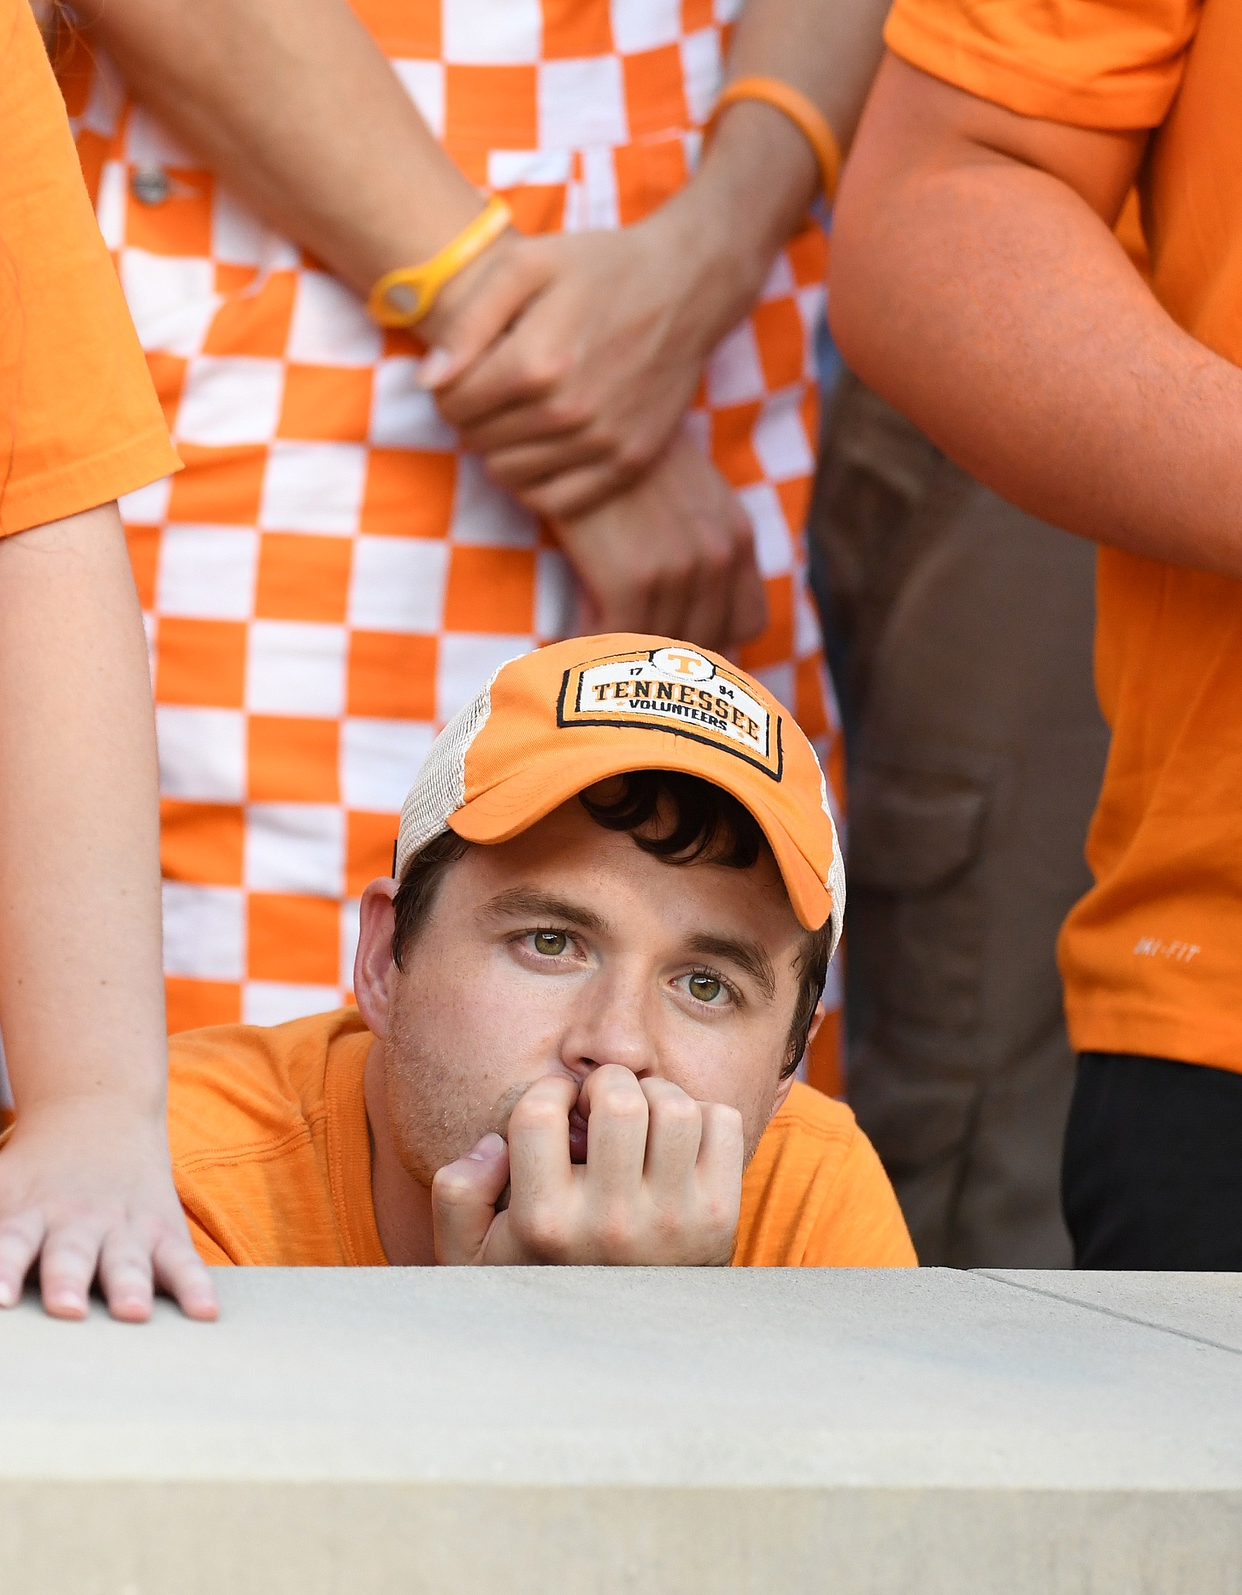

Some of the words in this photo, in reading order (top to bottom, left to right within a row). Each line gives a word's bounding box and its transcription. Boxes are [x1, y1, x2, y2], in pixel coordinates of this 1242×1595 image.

[630, 668, 643, 676] 17
[667, 654, 701, 675] T
[719, 685, 734, 699] 94
[592, 680, 760, 742] TENNESSEE
[629, 699, 728, 731] VOLUNTEERS
